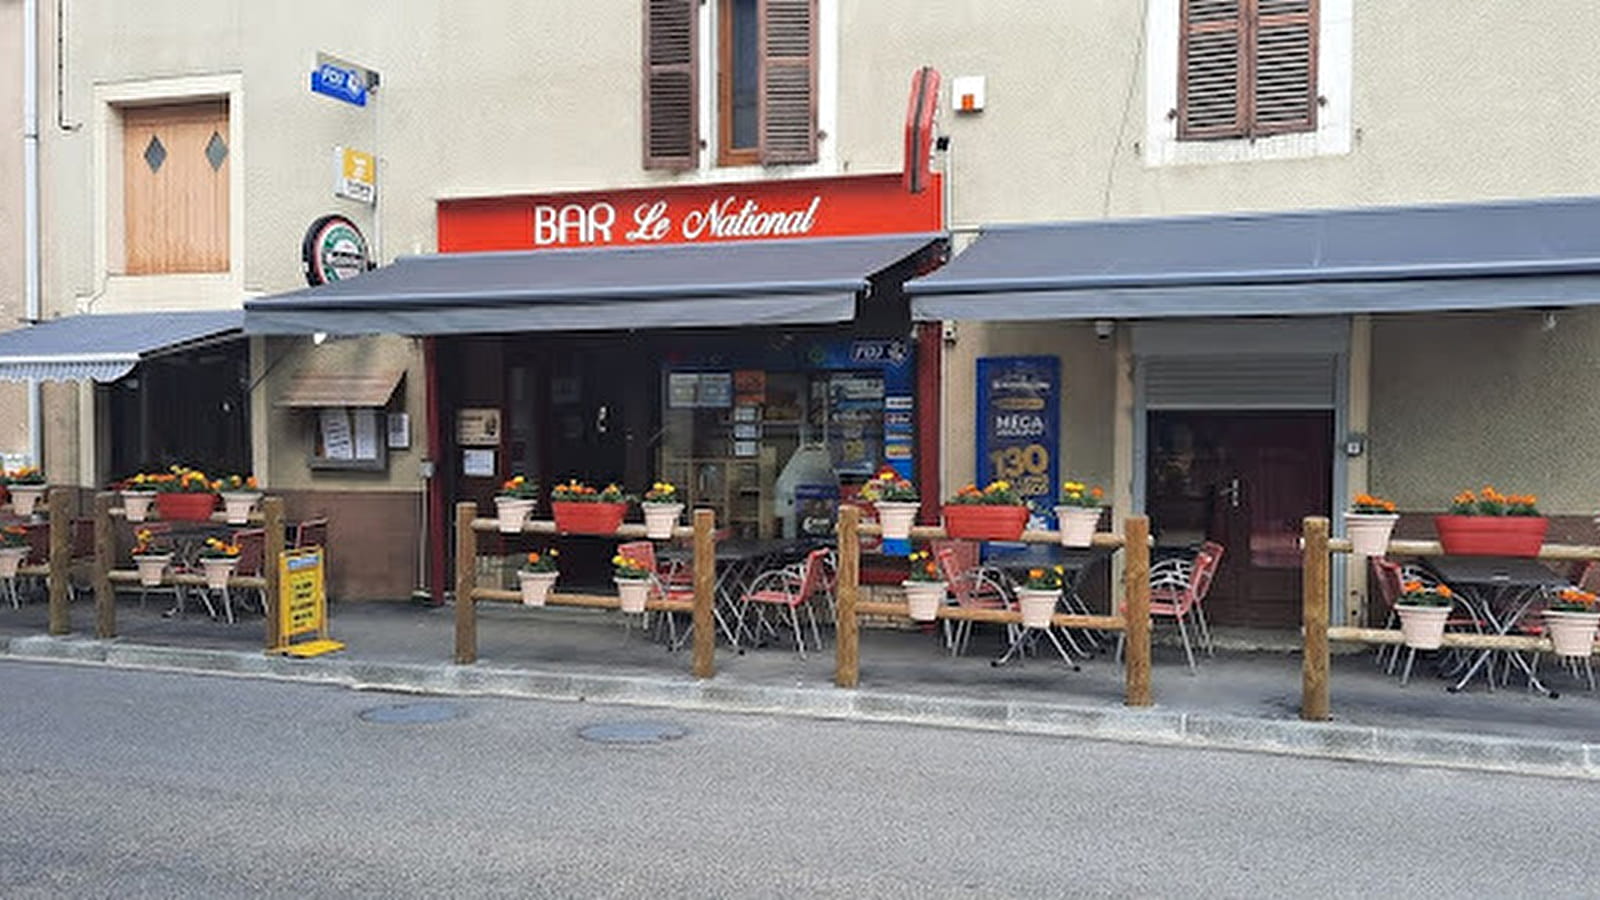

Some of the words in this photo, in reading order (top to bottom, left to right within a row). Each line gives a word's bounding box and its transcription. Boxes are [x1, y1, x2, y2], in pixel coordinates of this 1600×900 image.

[534, 203, 616, 244] BAR
[625, 201, 671, 241] Le
[682, 196, 821, 239] National
